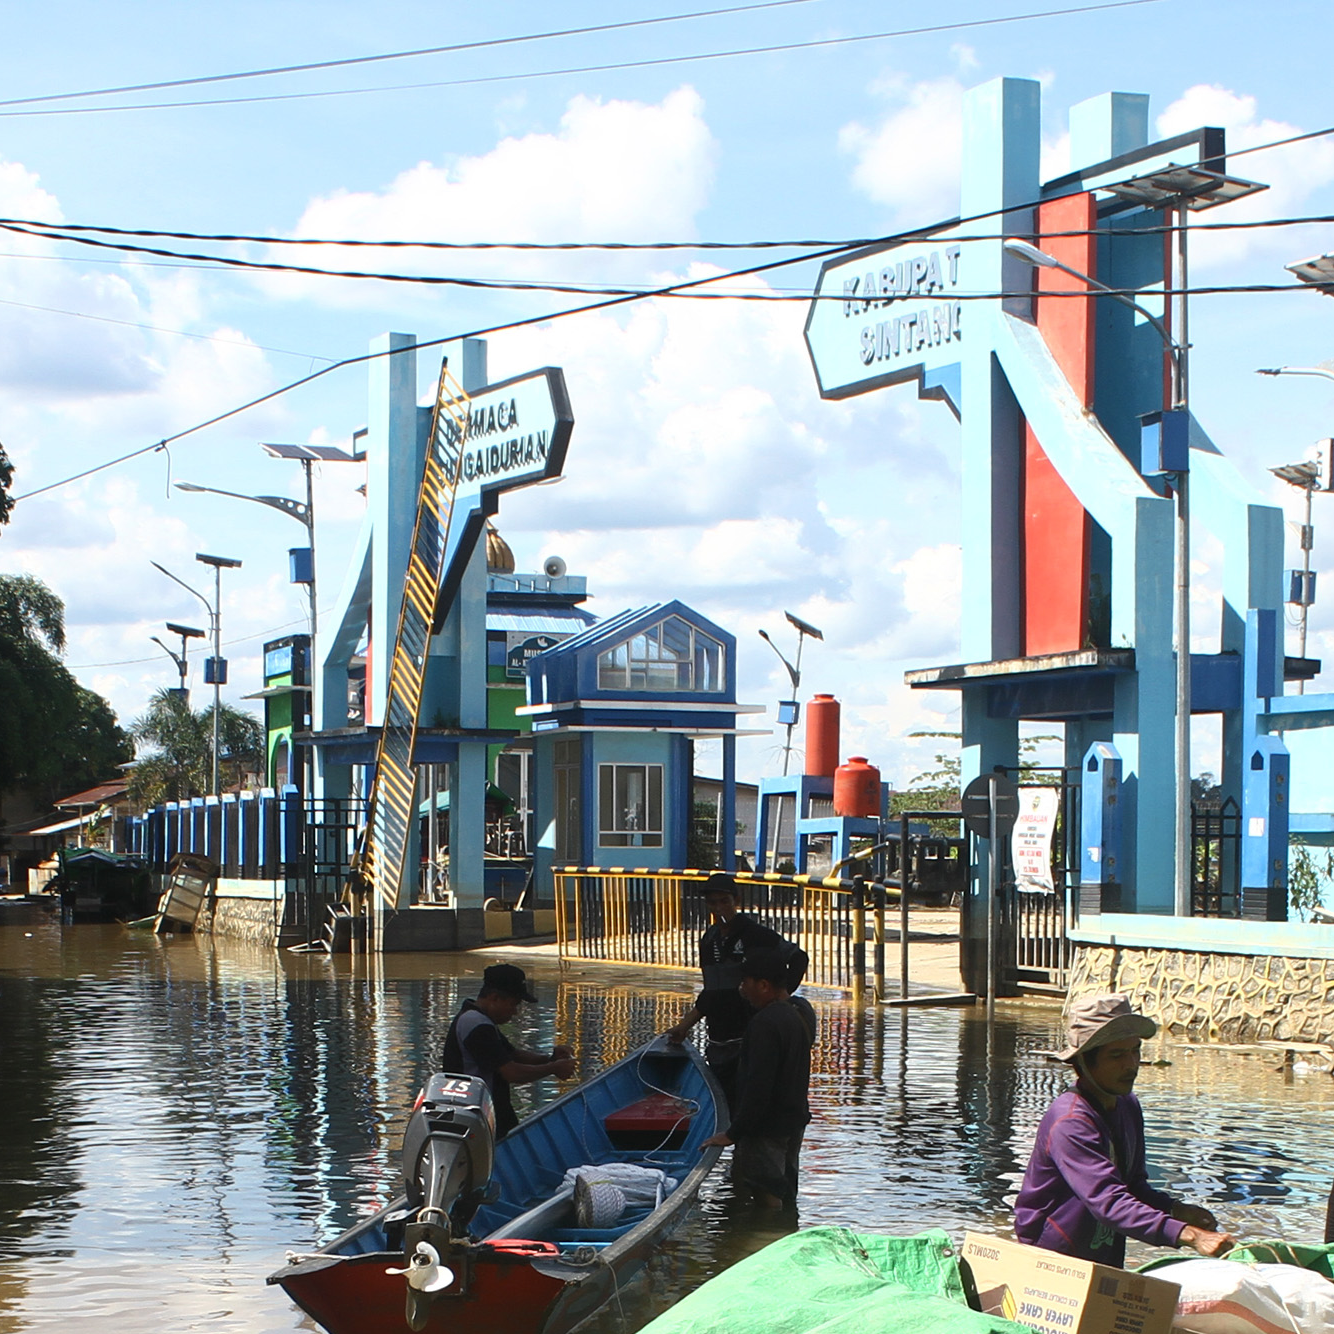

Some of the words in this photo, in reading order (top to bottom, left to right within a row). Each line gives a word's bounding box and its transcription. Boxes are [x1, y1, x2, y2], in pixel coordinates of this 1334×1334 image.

[442, 1079, 471, 1093] 15
[968, 1243, 1000, 1260] 3020MLS
[1019, 1302, 1043, 1321] CAKE
[1045, 1308, 1074, 1328] LAYER
